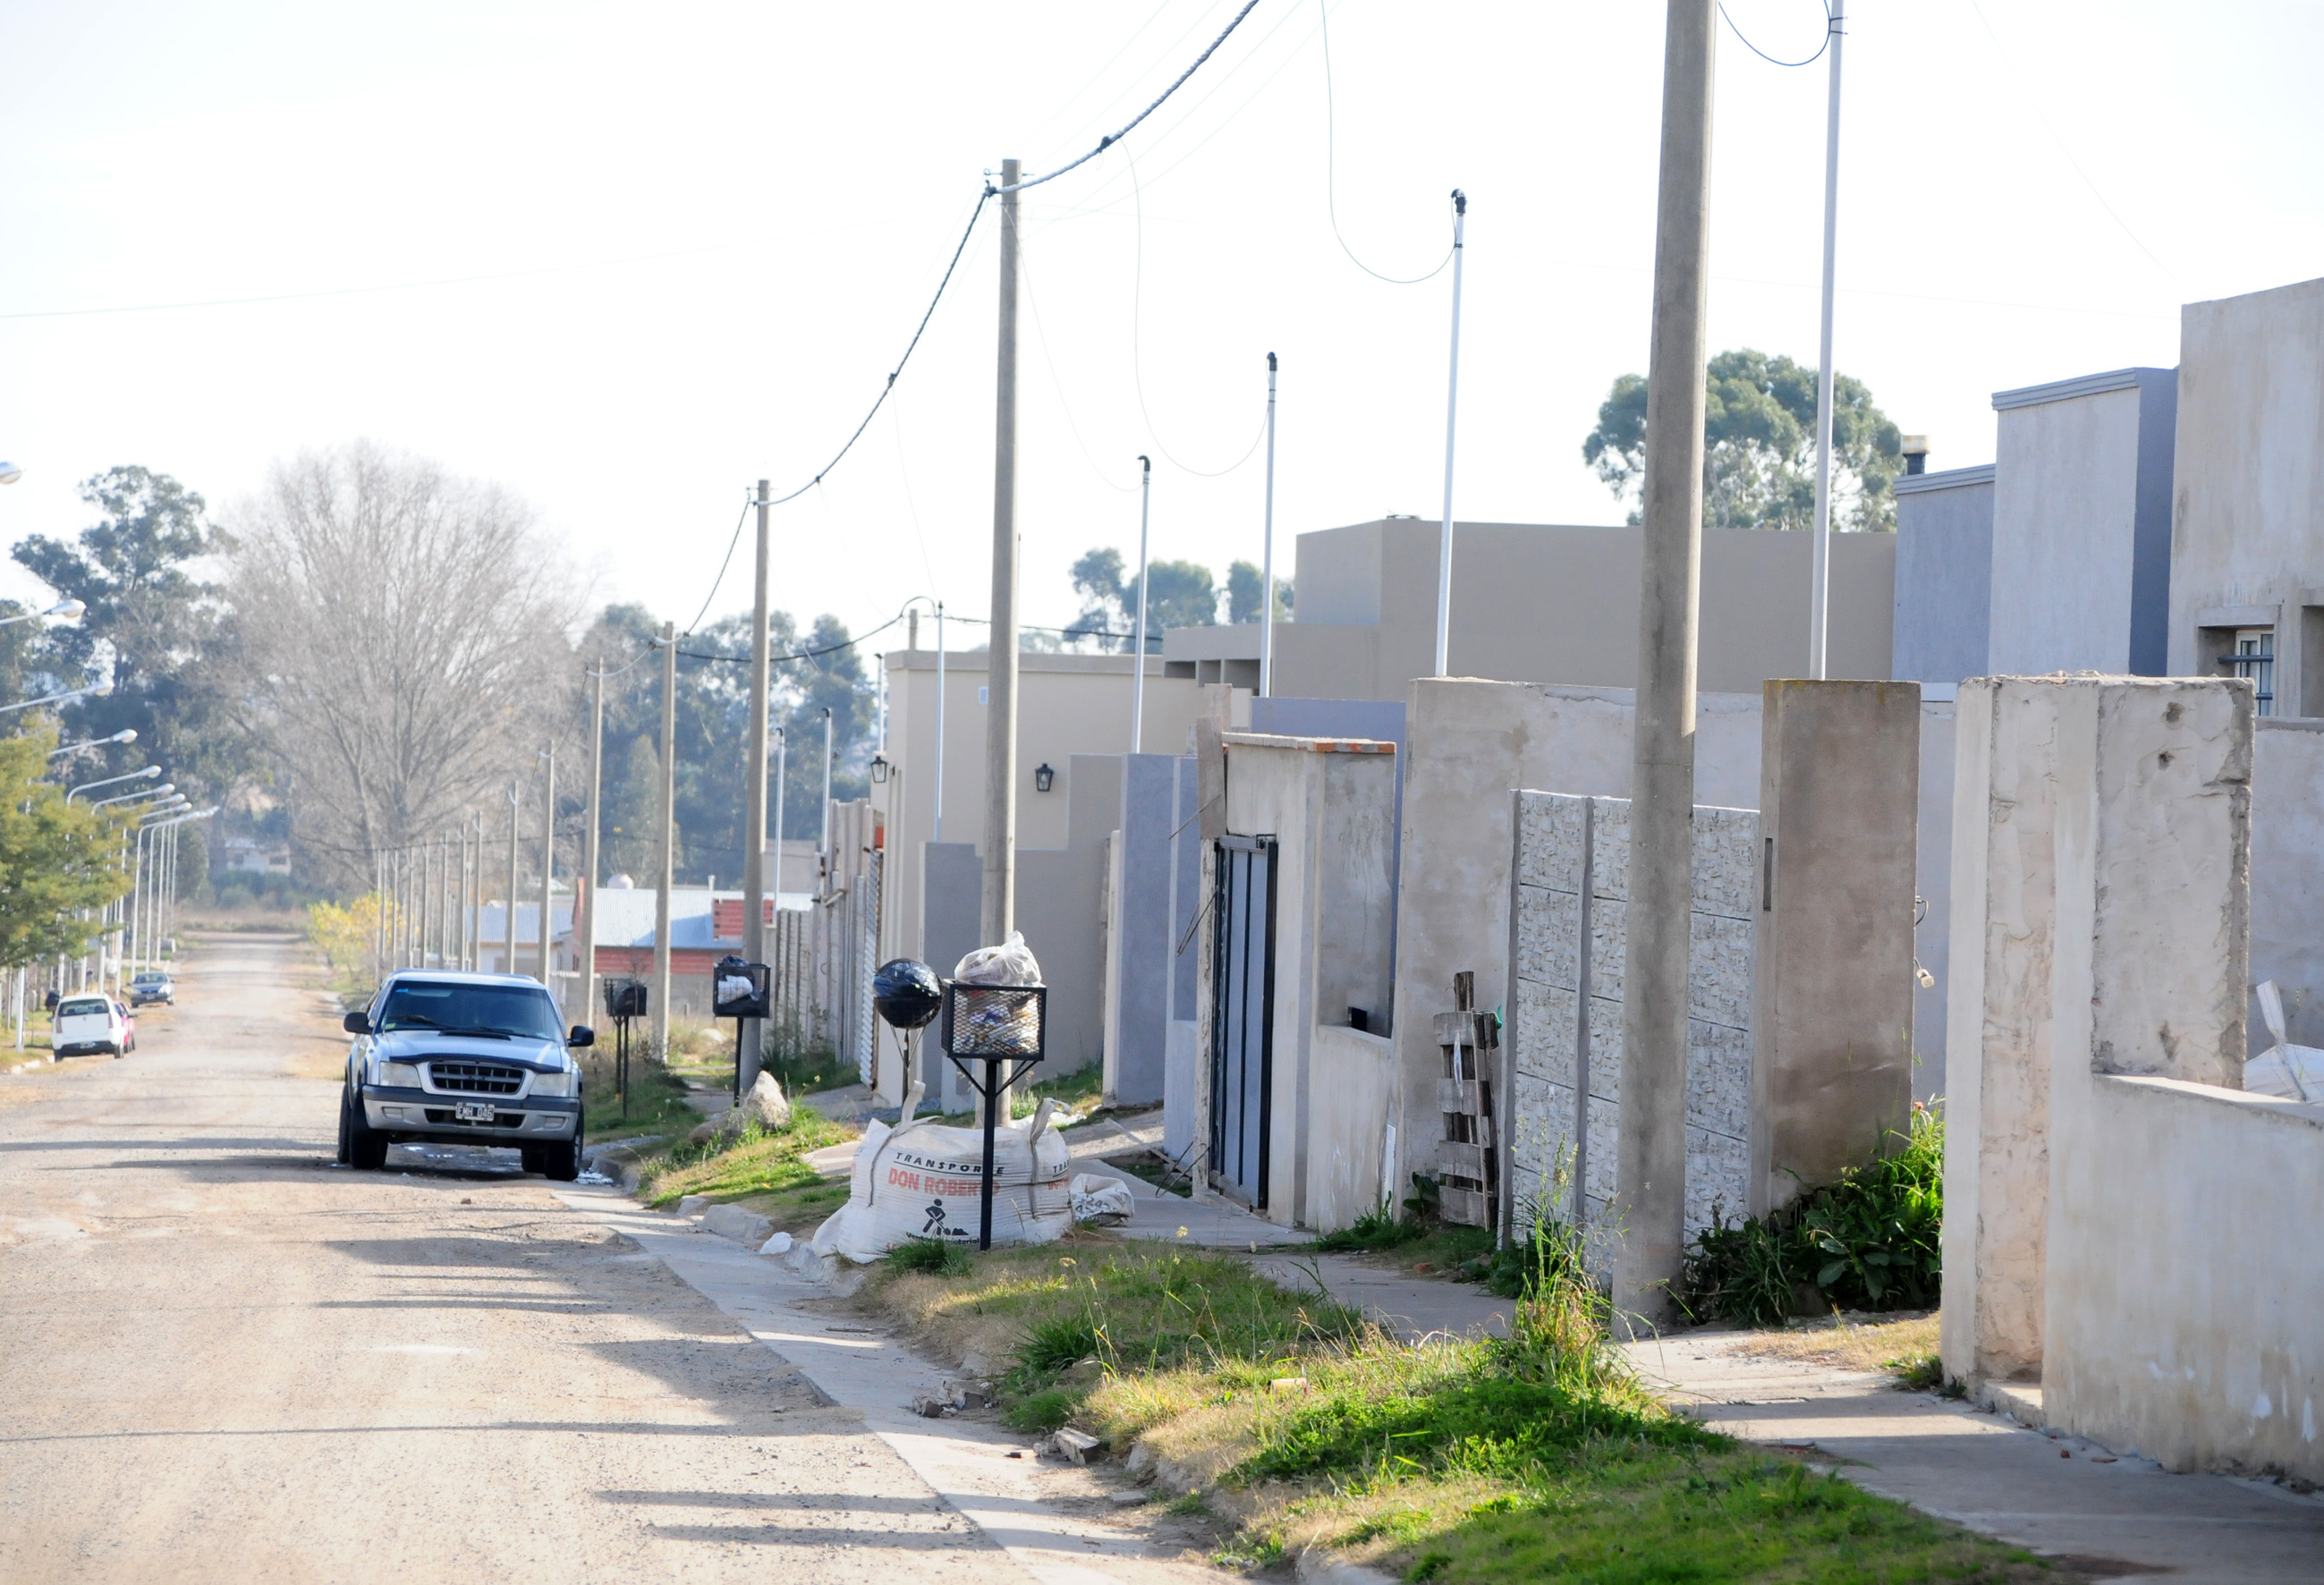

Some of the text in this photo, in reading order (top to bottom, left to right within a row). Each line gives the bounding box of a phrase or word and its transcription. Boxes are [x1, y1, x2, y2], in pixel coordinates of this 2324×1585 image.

[477, 1106, 494, 1118] 046
[896, 1152, 1005, 1174] TRANSPORE
[888, 1167, 1001, 1197] DON ROBERO
